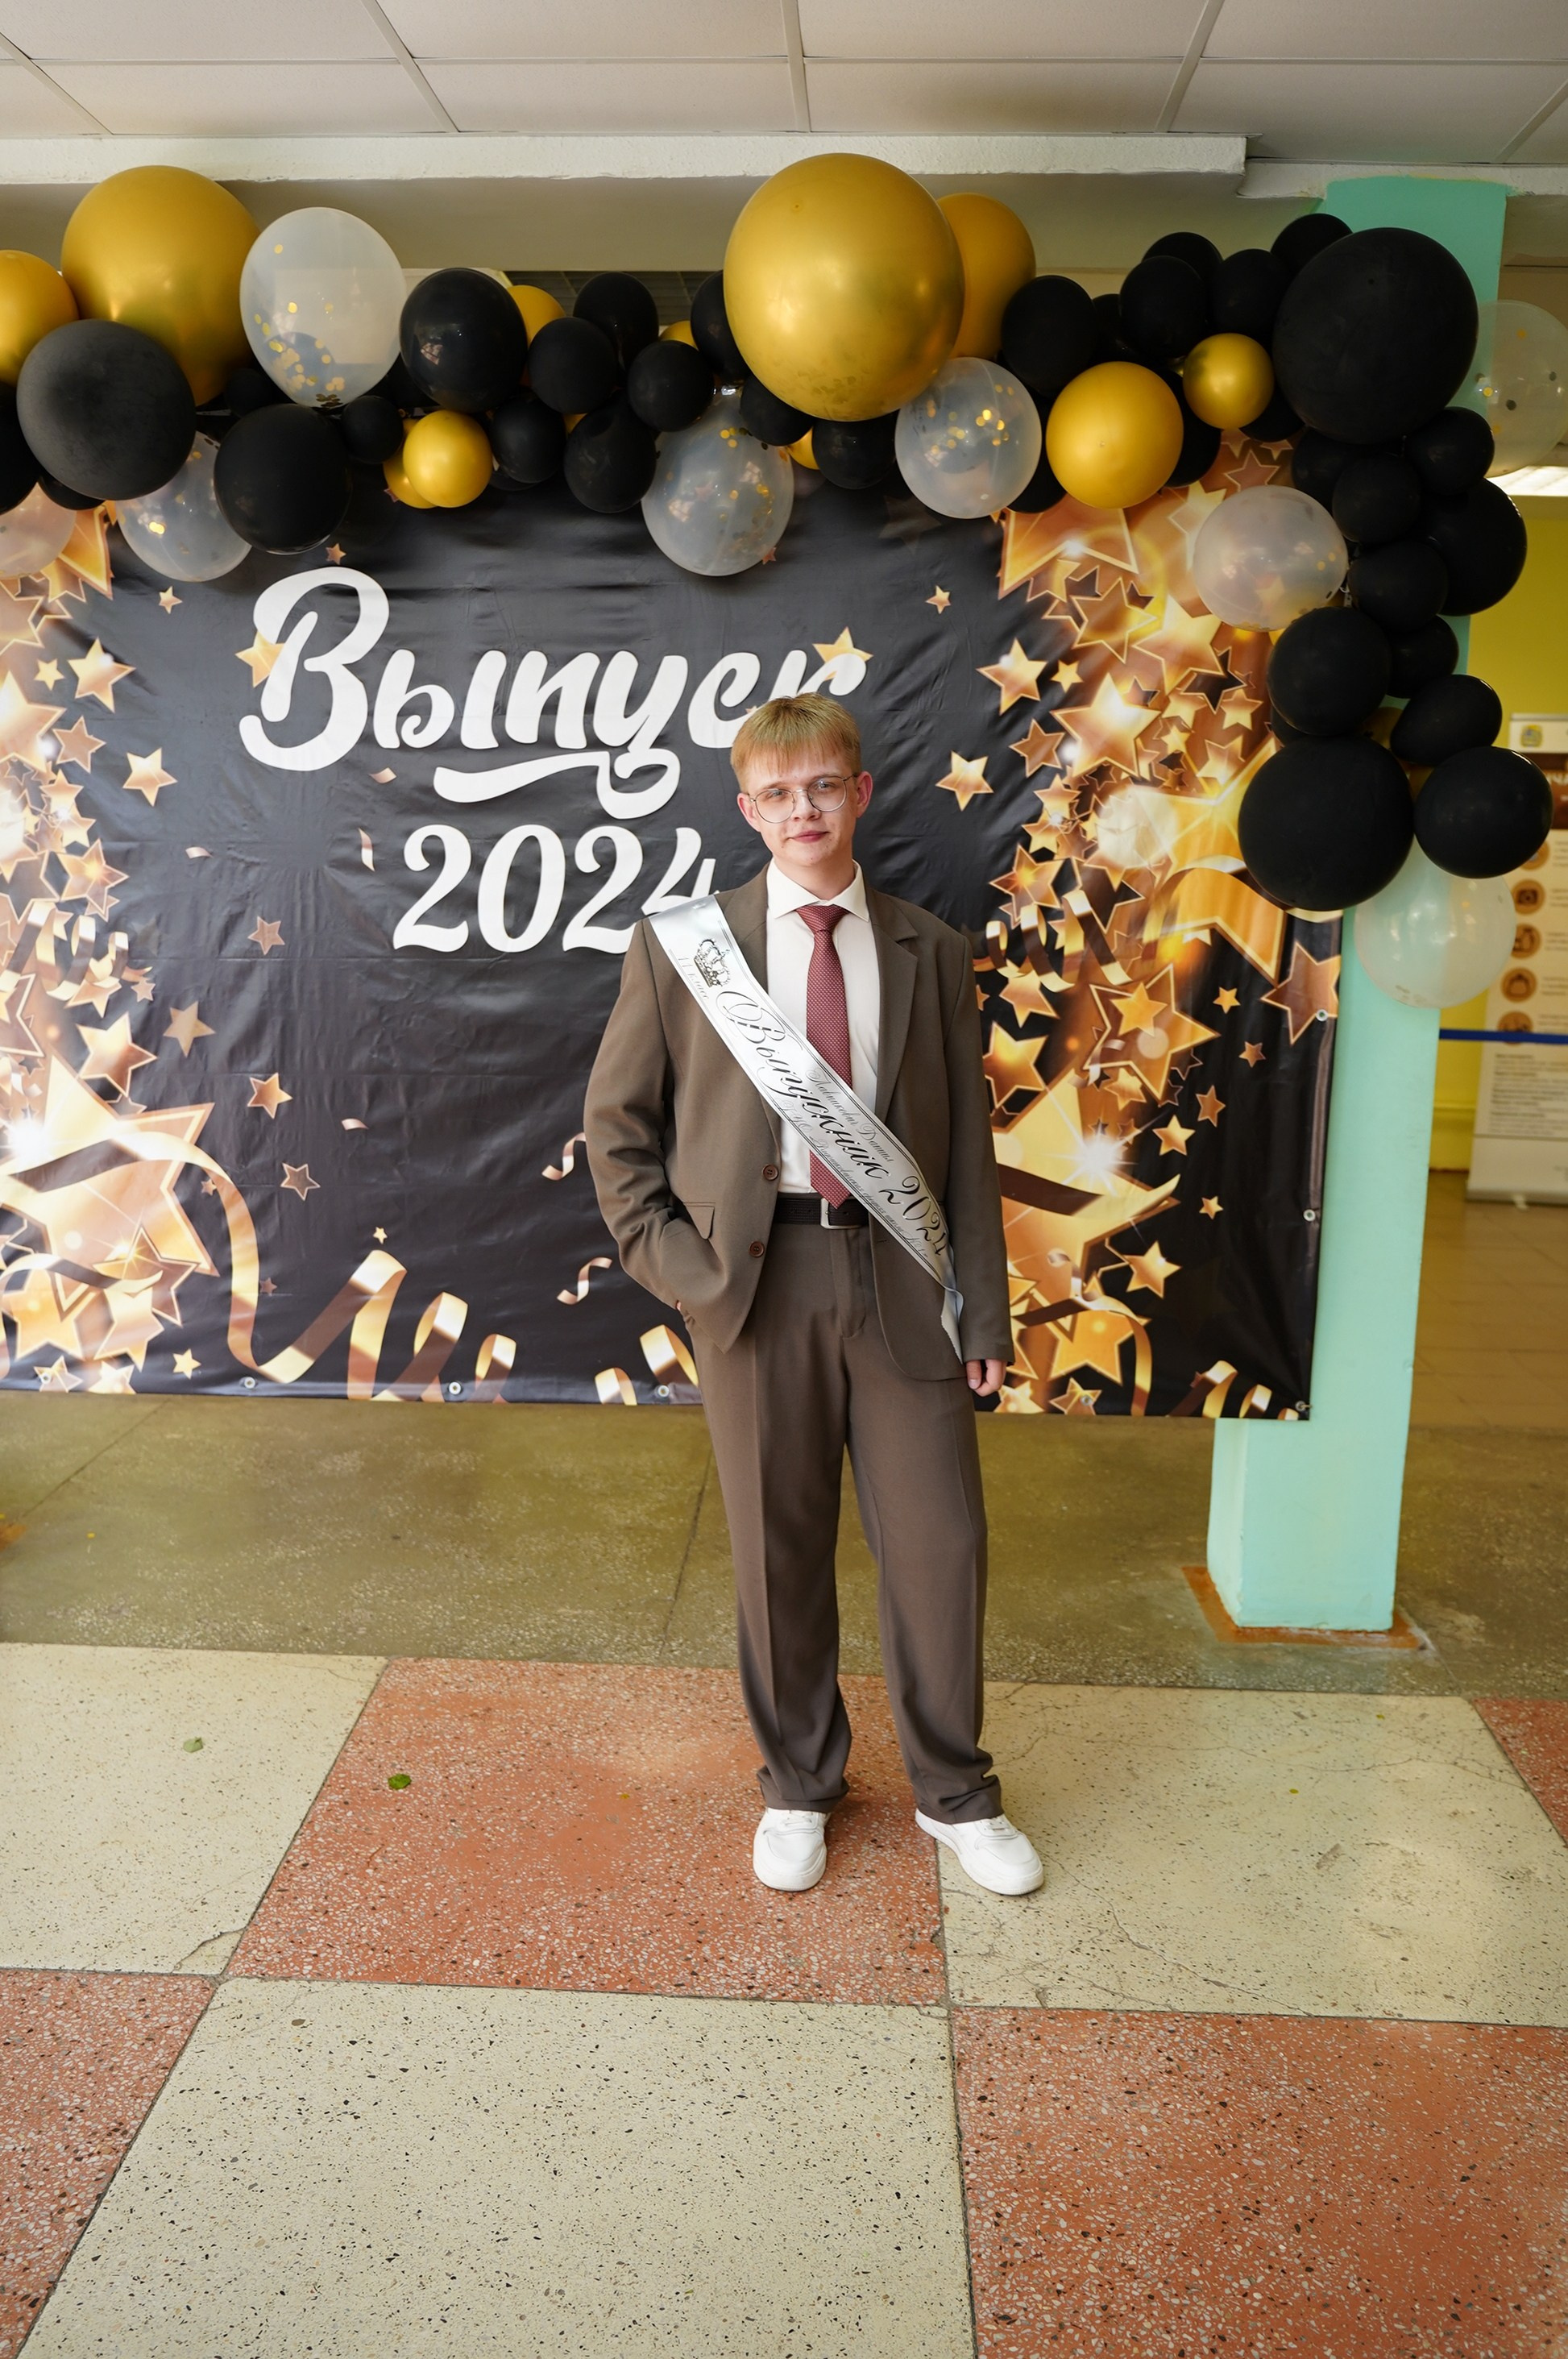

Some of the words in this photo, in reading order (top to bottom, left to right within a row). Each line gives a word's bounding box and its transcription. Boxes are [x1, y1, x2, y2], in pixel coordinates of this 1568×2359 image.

[392, 824, 717, 954] 2024
[716, 991, 890, 1180] Выпускник
[878, 1175, 947, 1256] 2024
[856, 1121, 894, 1163] Даниил
